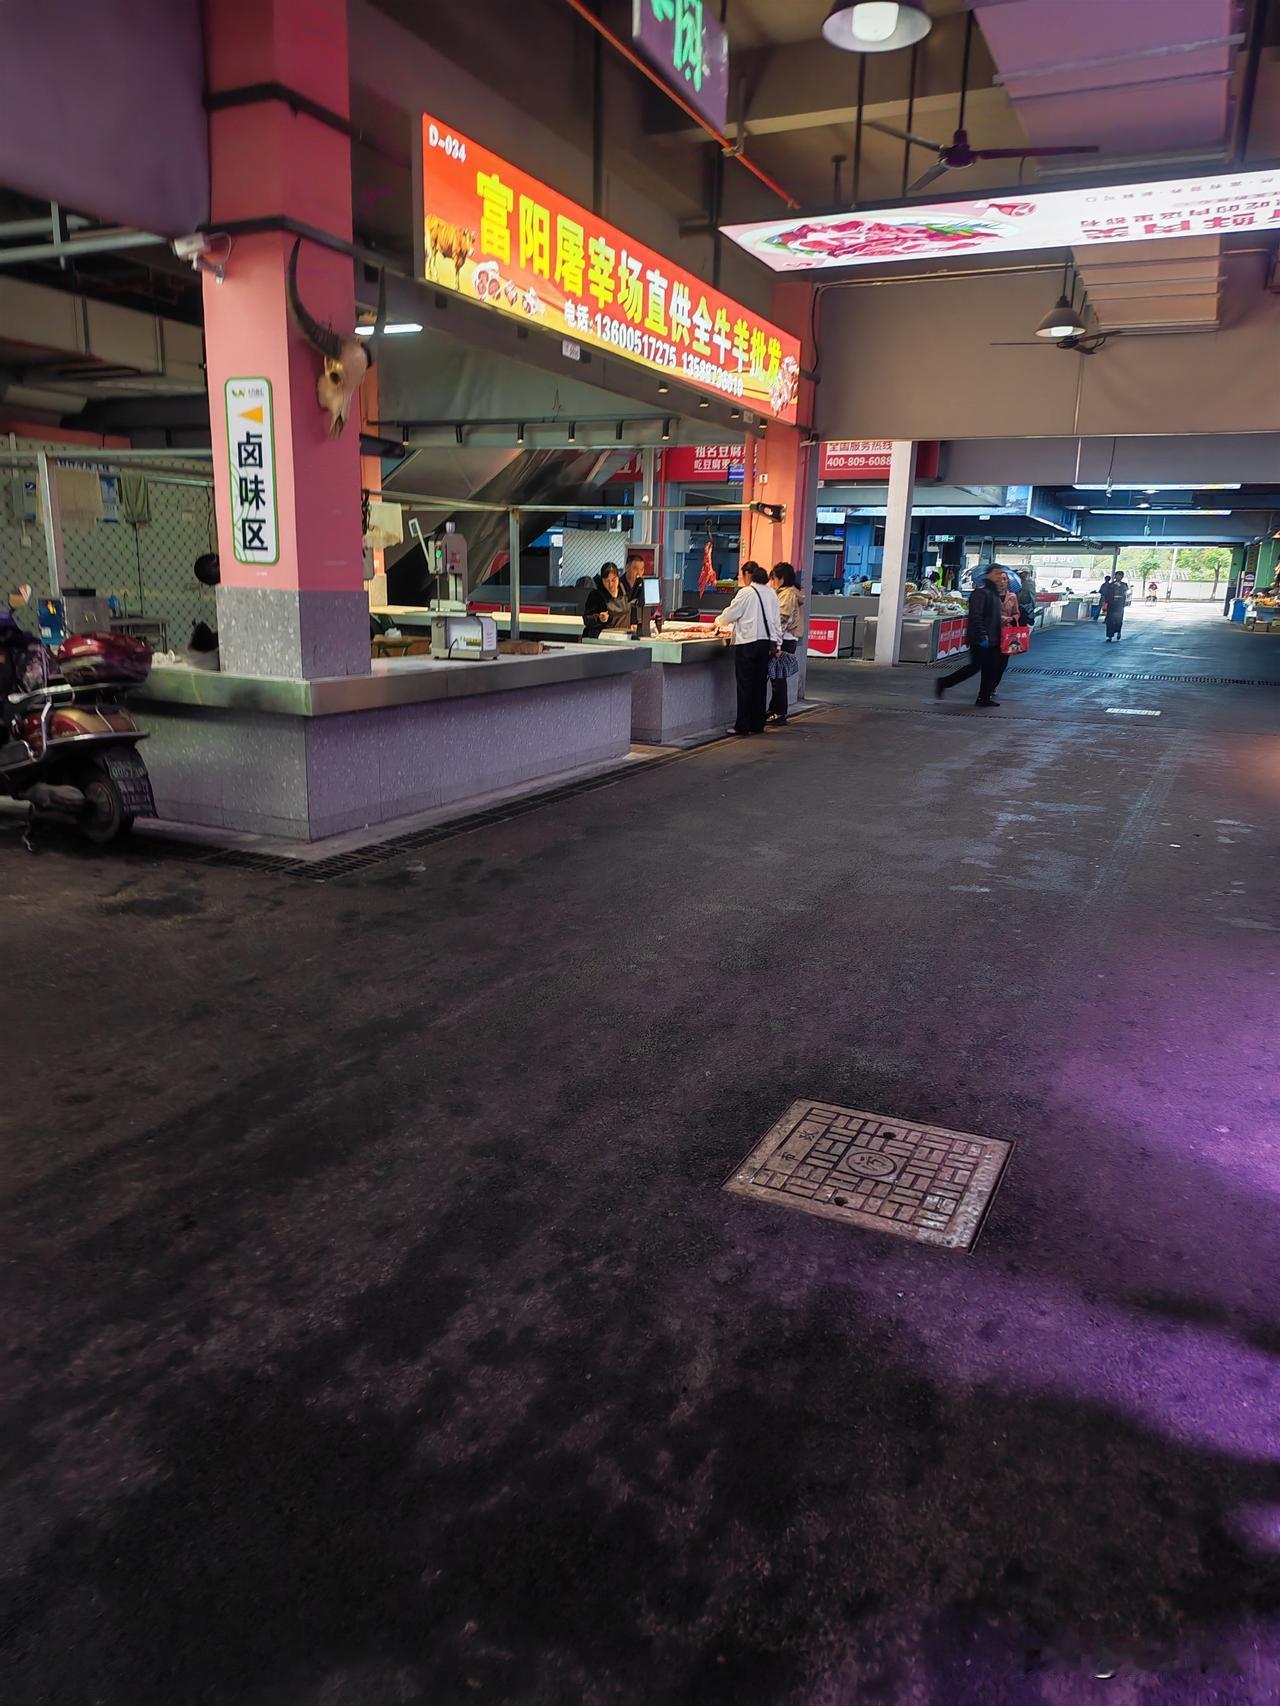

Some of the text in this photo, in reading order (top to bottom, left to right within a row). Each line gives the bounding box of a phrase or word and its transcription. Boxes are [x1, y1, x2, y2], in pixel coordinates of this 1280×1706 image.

[1080, 199, 1280, 227] 吃的肉这里都有
[476, 171, 783, 386] 富阳屠宰场直供全牛羊批发
[695, 445, 746, 458] 祖名豆腐
[237, 431, 269, 551] 卤味区
